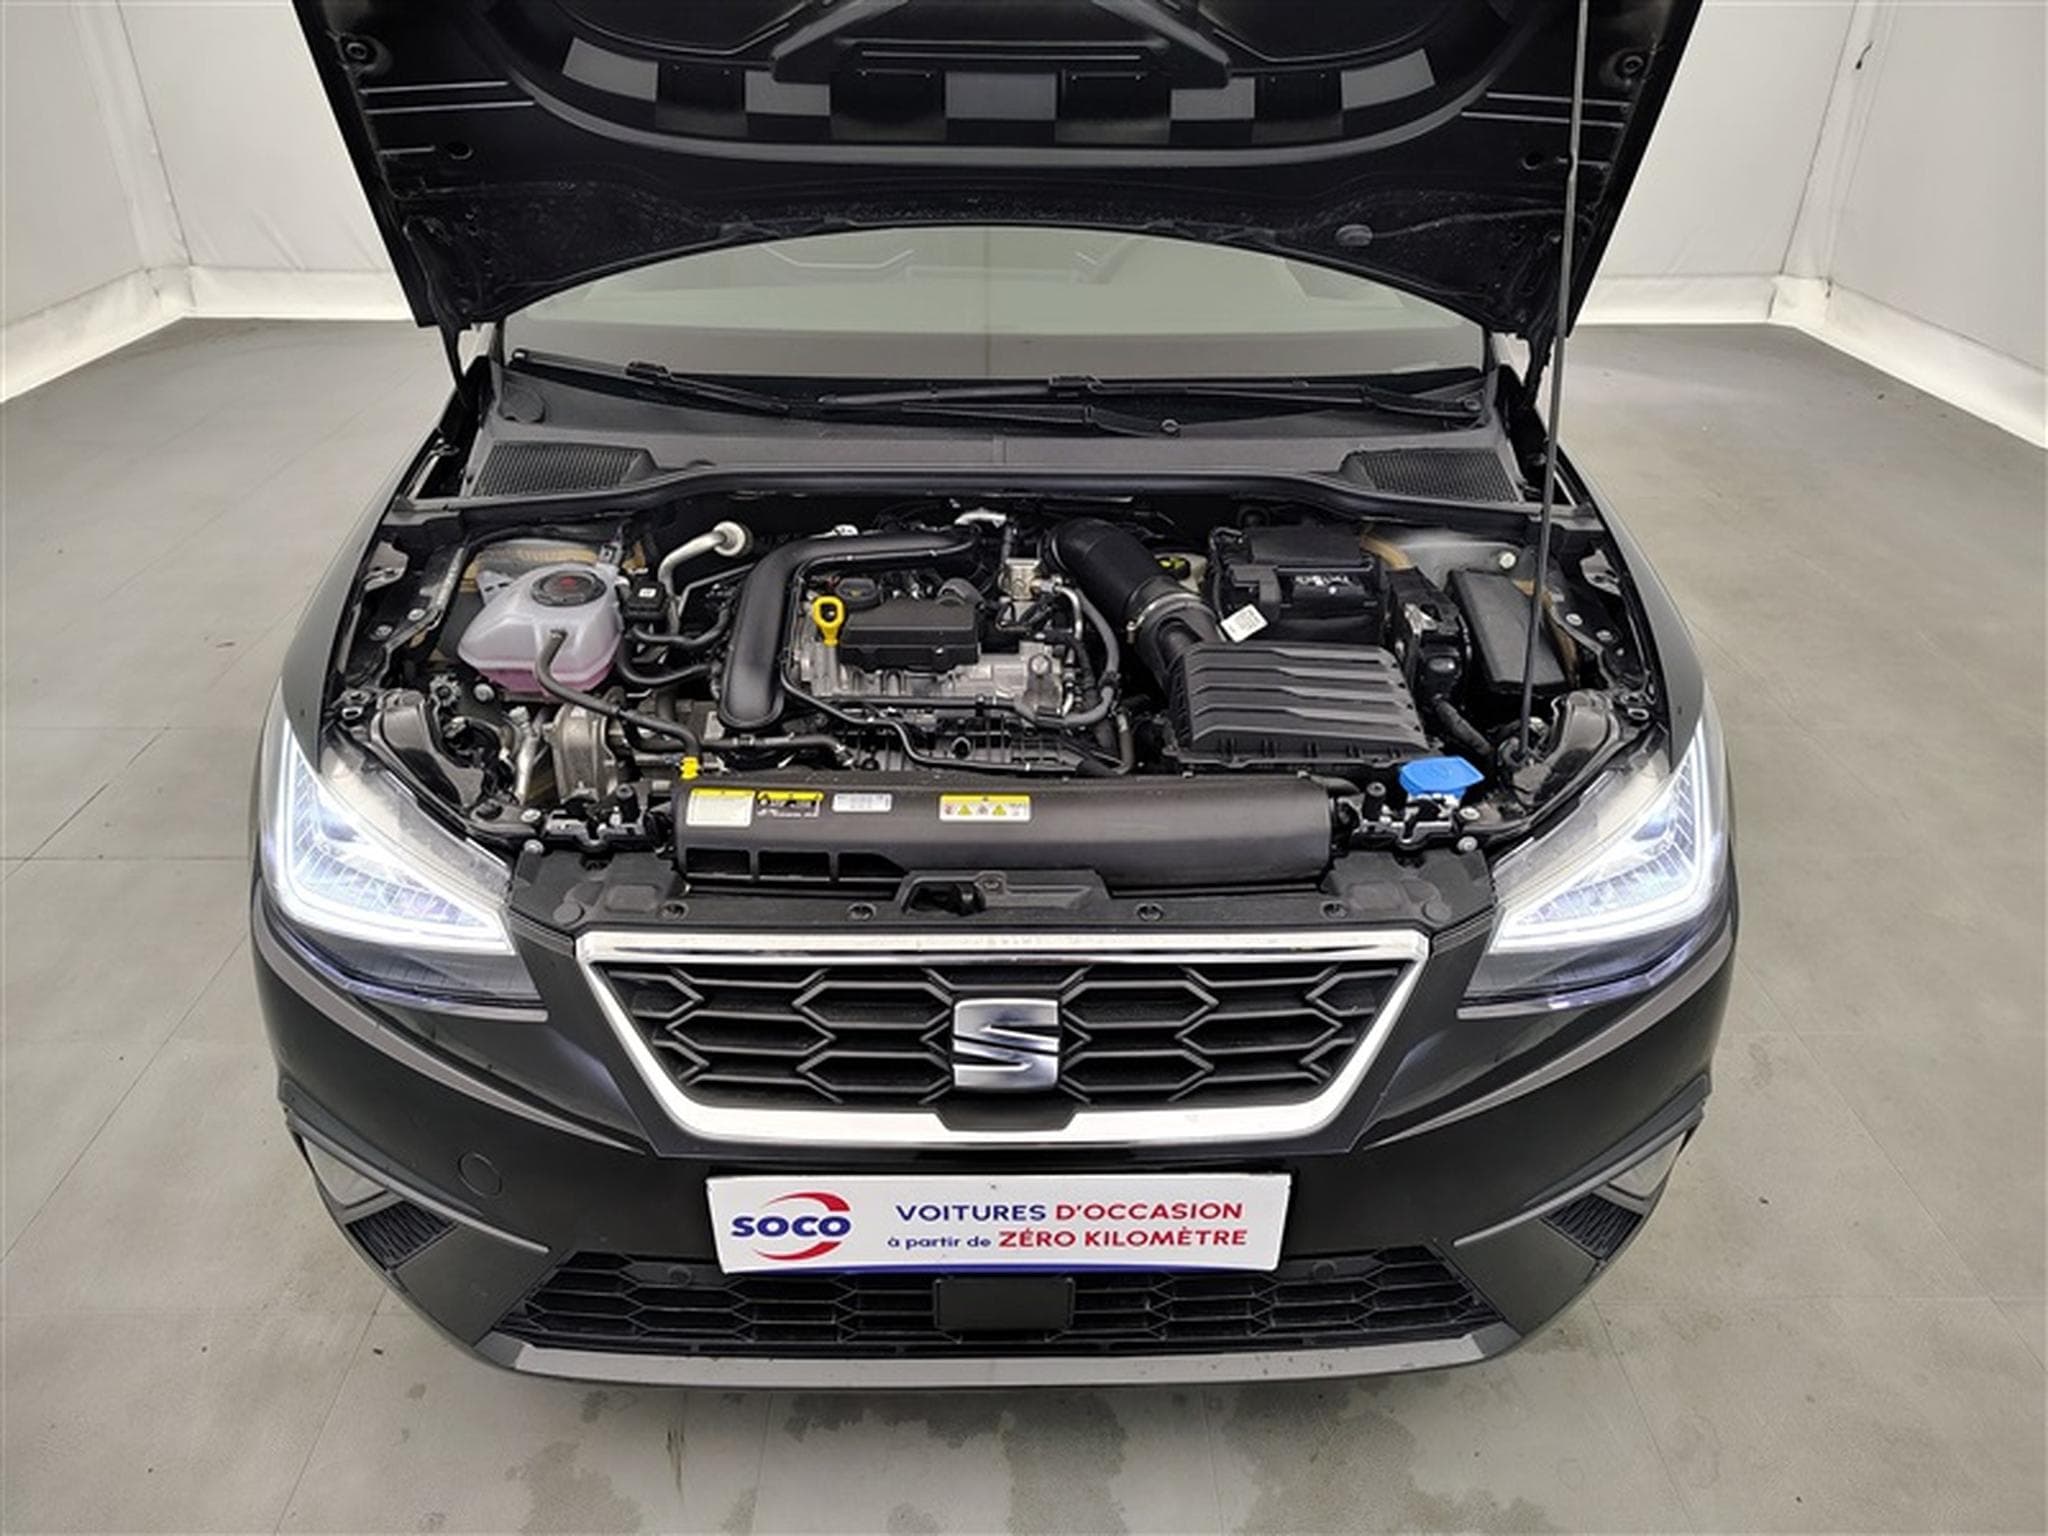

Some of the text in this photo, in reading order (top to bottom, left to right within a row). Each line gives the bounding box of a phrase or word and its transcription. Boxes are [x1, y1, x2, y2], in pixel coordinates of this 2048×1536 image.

[895, 1203, 1243, 1222] VOITURES D'OCCASION
[731, 1216, 851, 1238] SOCO
[887, 1226, 1248, 1250] à partir de ZÉRO KILOMÈTRE
